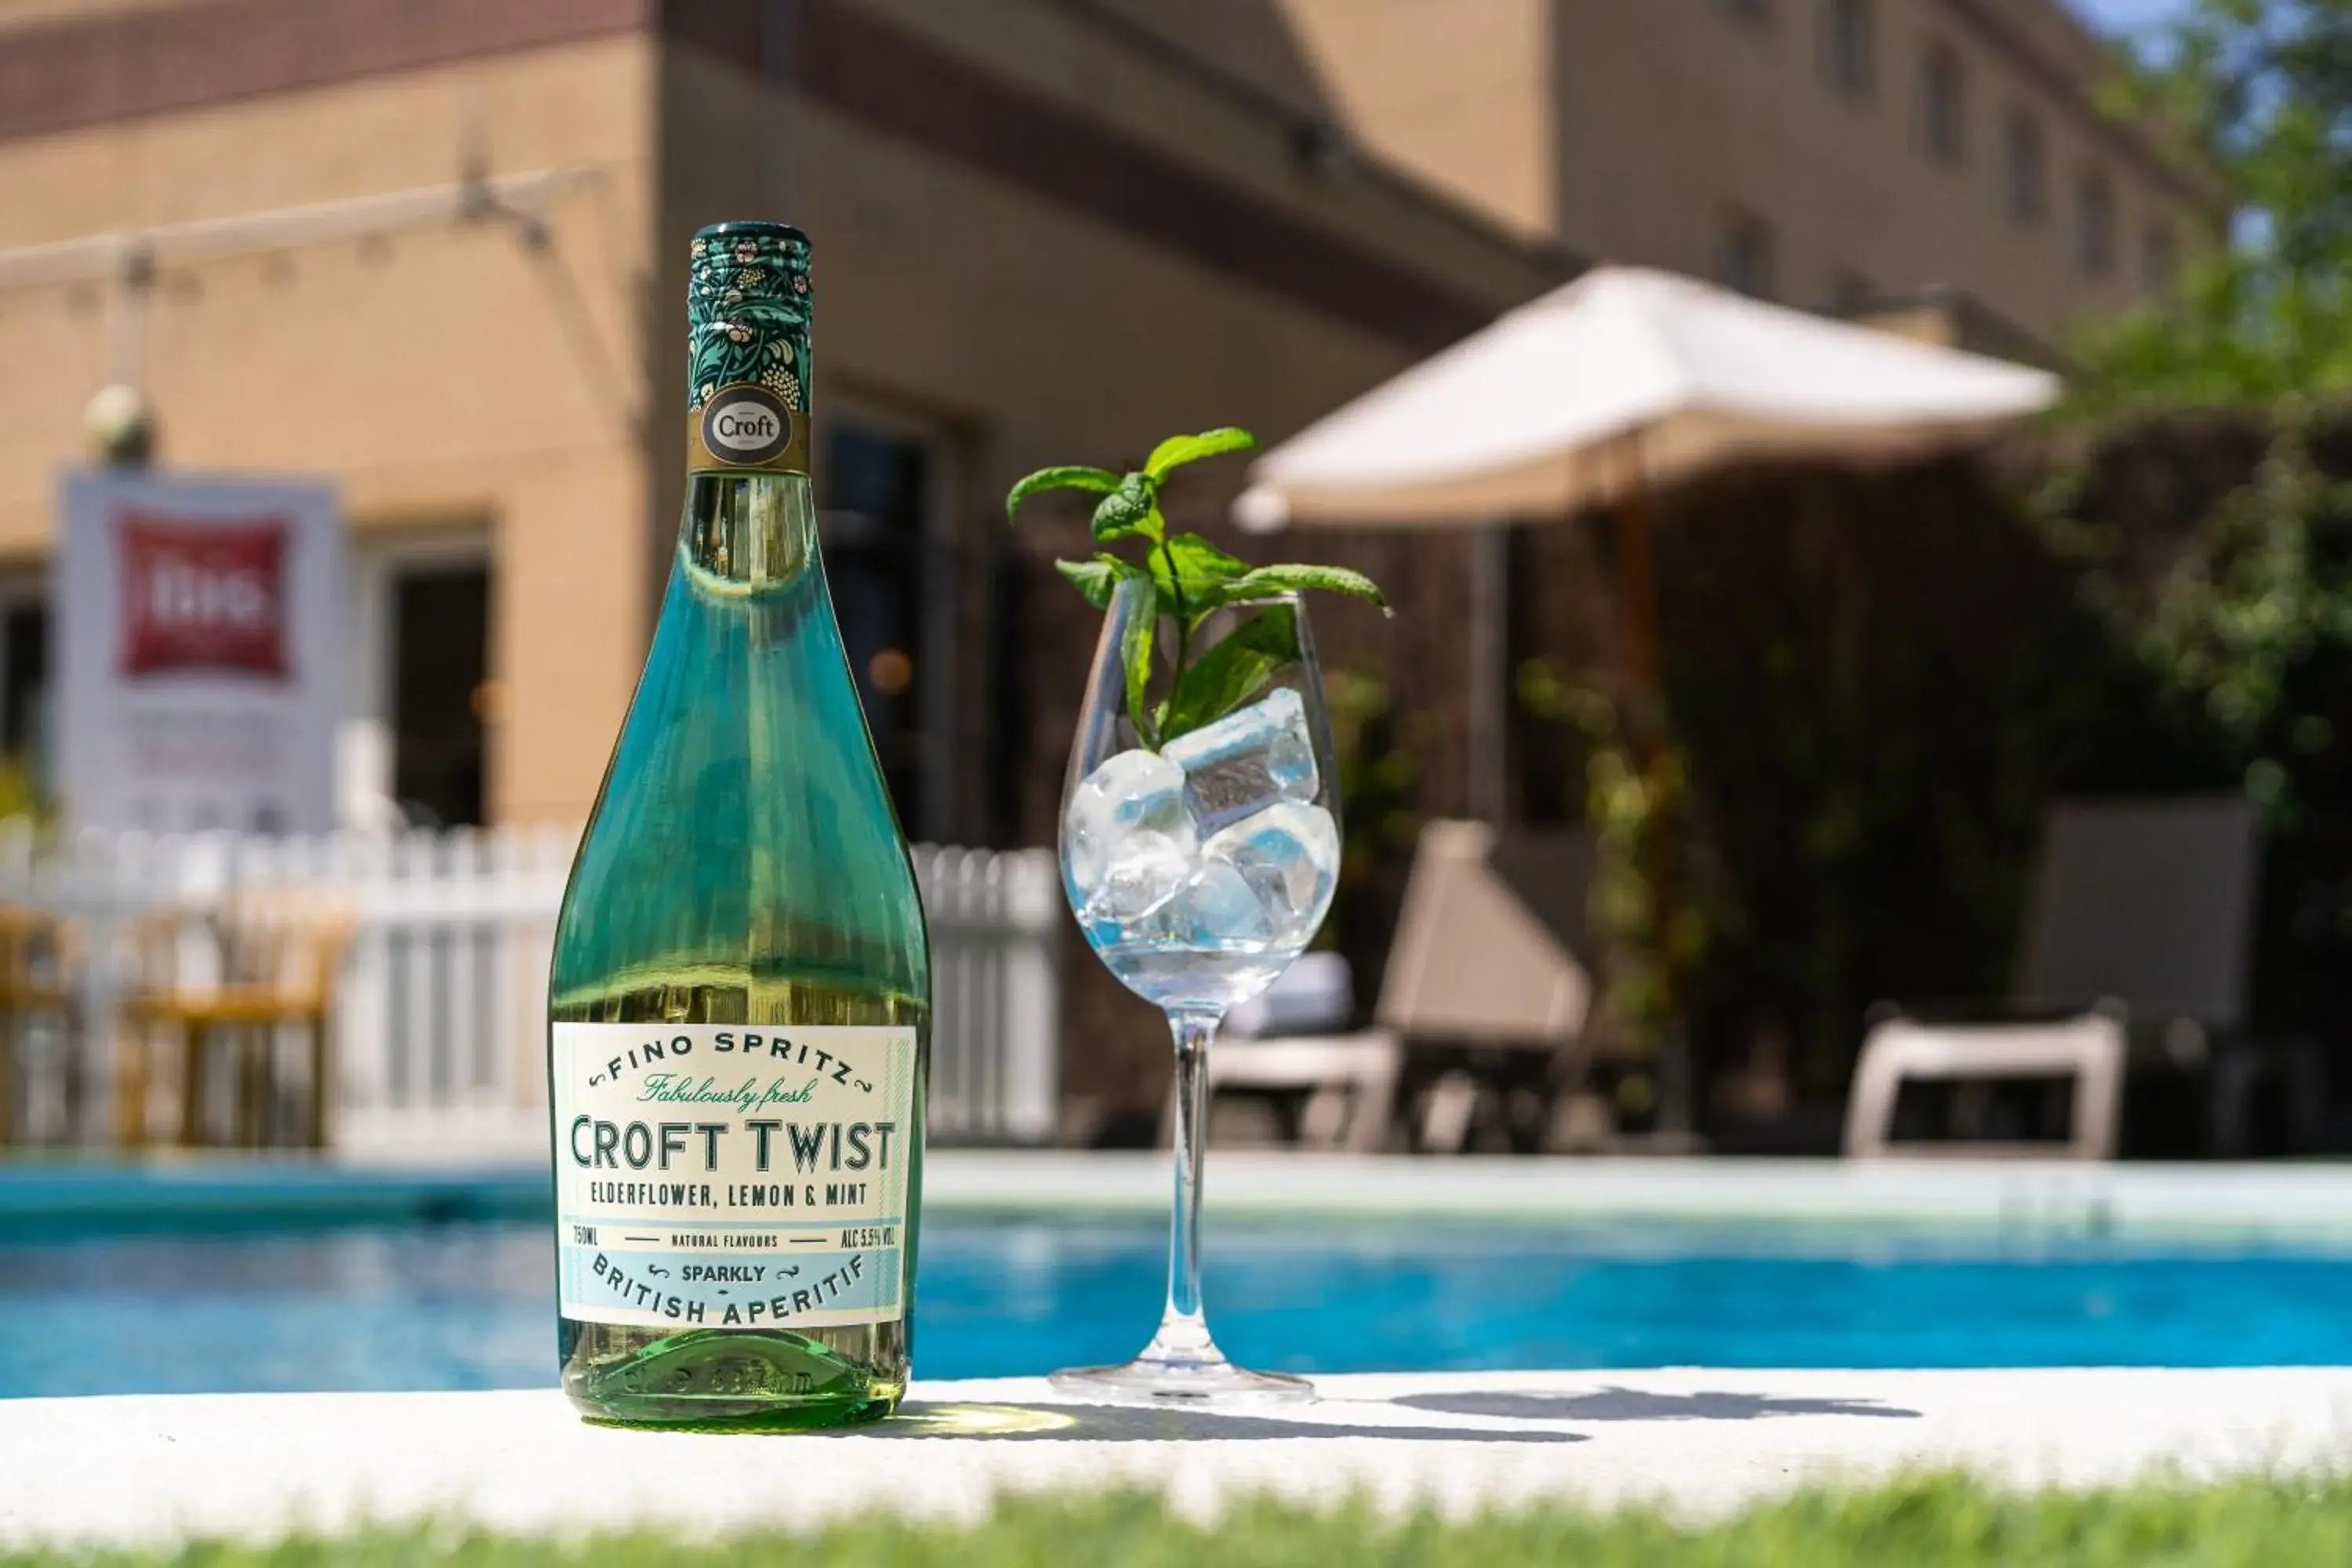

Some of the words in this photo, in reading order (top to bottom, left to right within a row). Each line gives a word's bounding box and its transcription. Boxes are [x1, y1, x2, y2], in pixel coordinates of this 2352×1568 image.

[718, 415, 774, 437] Croft
[608, 1035, 692, 1080] FINO
[714, 1033, 852, 1085] SPRITZ
[637, 1073, 757, 1113] Fabulously
[755, 1076, 818, 1113] fresh
[571, 1114, 729, 1171] CROFT
[744, 1118, 896, 1175] TWIST
[590, 1181, 717, 1209] ELDERFLOWER,
[728, 1184, 795, 1207] LEMON
[805, 1184, 816, 1207] &
[826, 1182, 867, 1206] MINT
[672, 1235, 719, 1247] NATURAL
[724, 1235, 779, 1247] FLAVOURS
[592, 1252, 705, 1323] BRITISH
[722, 1254, 864, 1325] APERITIF
[682, 1265, 766, 1283] SPARKLY
